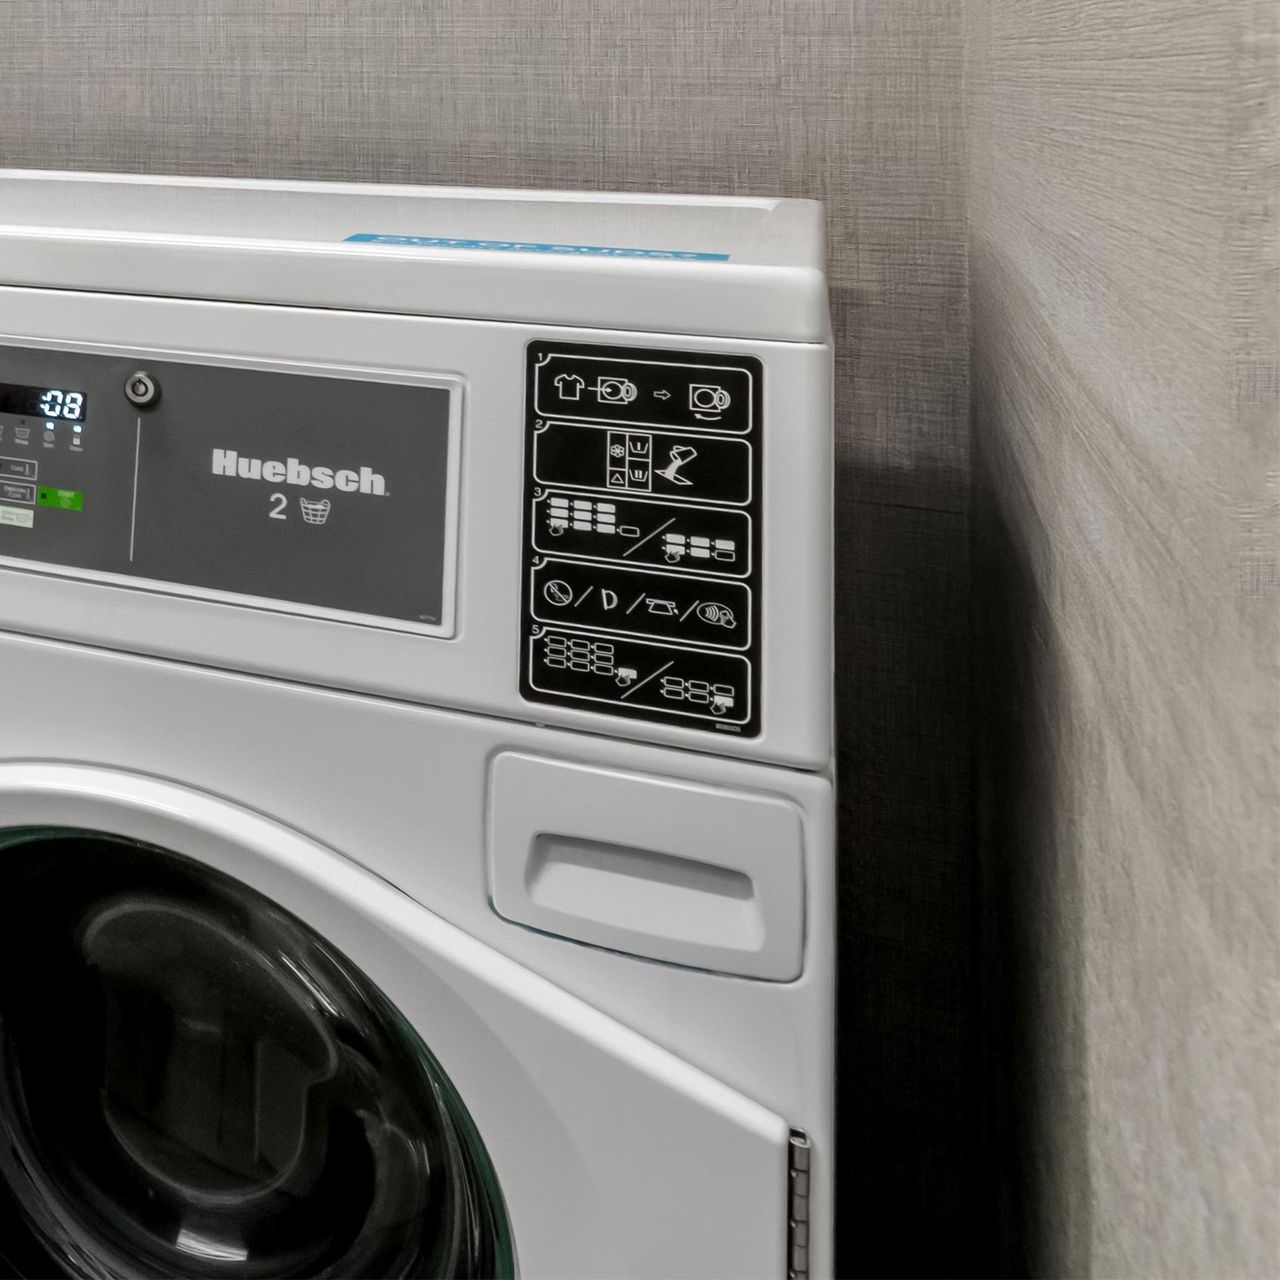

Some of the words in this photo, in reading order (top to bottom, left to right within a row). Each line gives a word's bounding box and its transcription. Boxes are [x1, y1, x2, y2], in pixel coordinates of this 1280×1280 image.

[535, 418, 543, 429] 2
[212, 448, 387, 496] Huebsch
[534, 487, 541, 497] 3
[268, 492, 288, 520] 2
[532, 555, 540, 565] 4
[531, 624, 540, 634] 5
